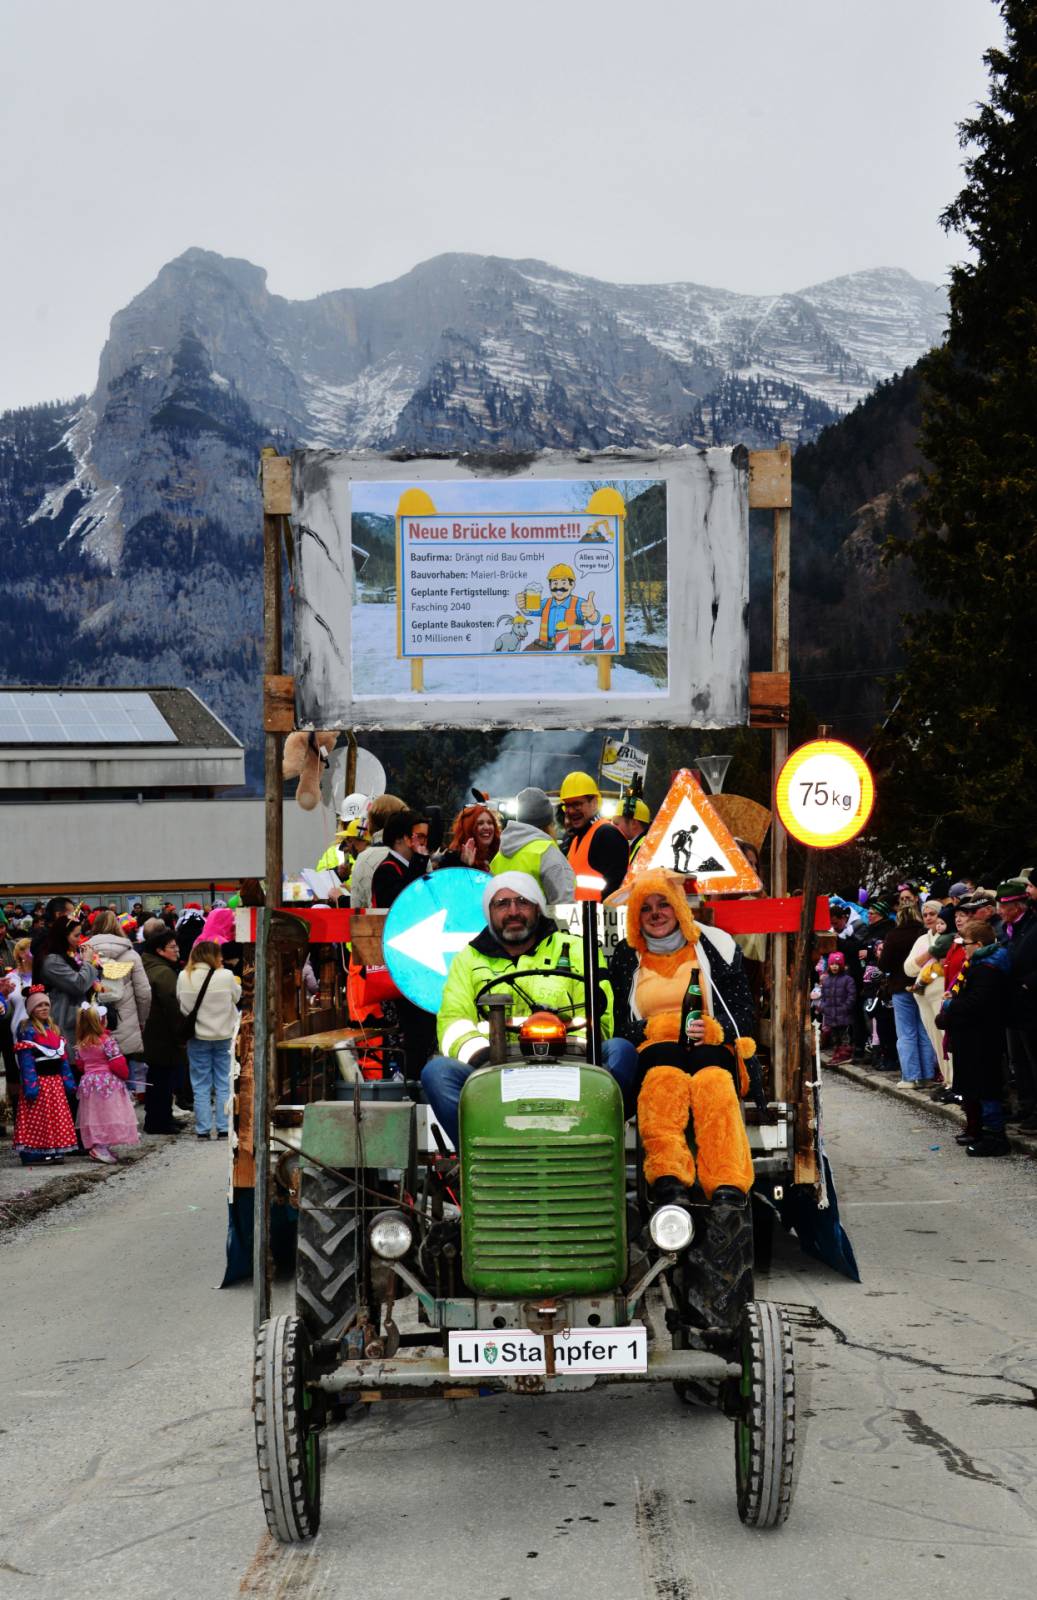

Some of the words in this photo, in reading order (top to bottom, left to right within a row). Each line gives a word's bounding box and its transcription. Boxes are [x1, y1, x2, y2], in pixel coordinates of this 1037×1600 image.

[409, 523, 448, 539] Neue
[453, 522, 506, 539] Brücke
[511, 522, 580, 538] kommt!!!
[410, 552, 452, 561] Baufirma:
[455, 552, 483, 563] Drängt
[486, 552, 499, 561] nid
[502, 552, 517, 561] Bau
[520, 552, 545, 561] GmbH
[410, 570, 468, 579] Bauvorhaben:
[471, 570, 528, 579] Maierl-Brücke
[411, 588, 448, 598] Geplante
[450, 588, 510, 598] Fertigstellung:
[411, 602, 448, 612] Fasching
[450, 602, 471, 611] 2040
[411, 621, 448, 630] Geplante
[450, 620, 495, 629] Baukosten:
[412, 634, 422, 642] 10
[425, 634, 463, 642] Millionen
[465, 633, 472, 642] €
[799, 781, 829, 806] 75
[832, 790, 852, 811] kg
[458, 1343, 479, 1363] LI
[627, 1340, 637, 1360] 1
